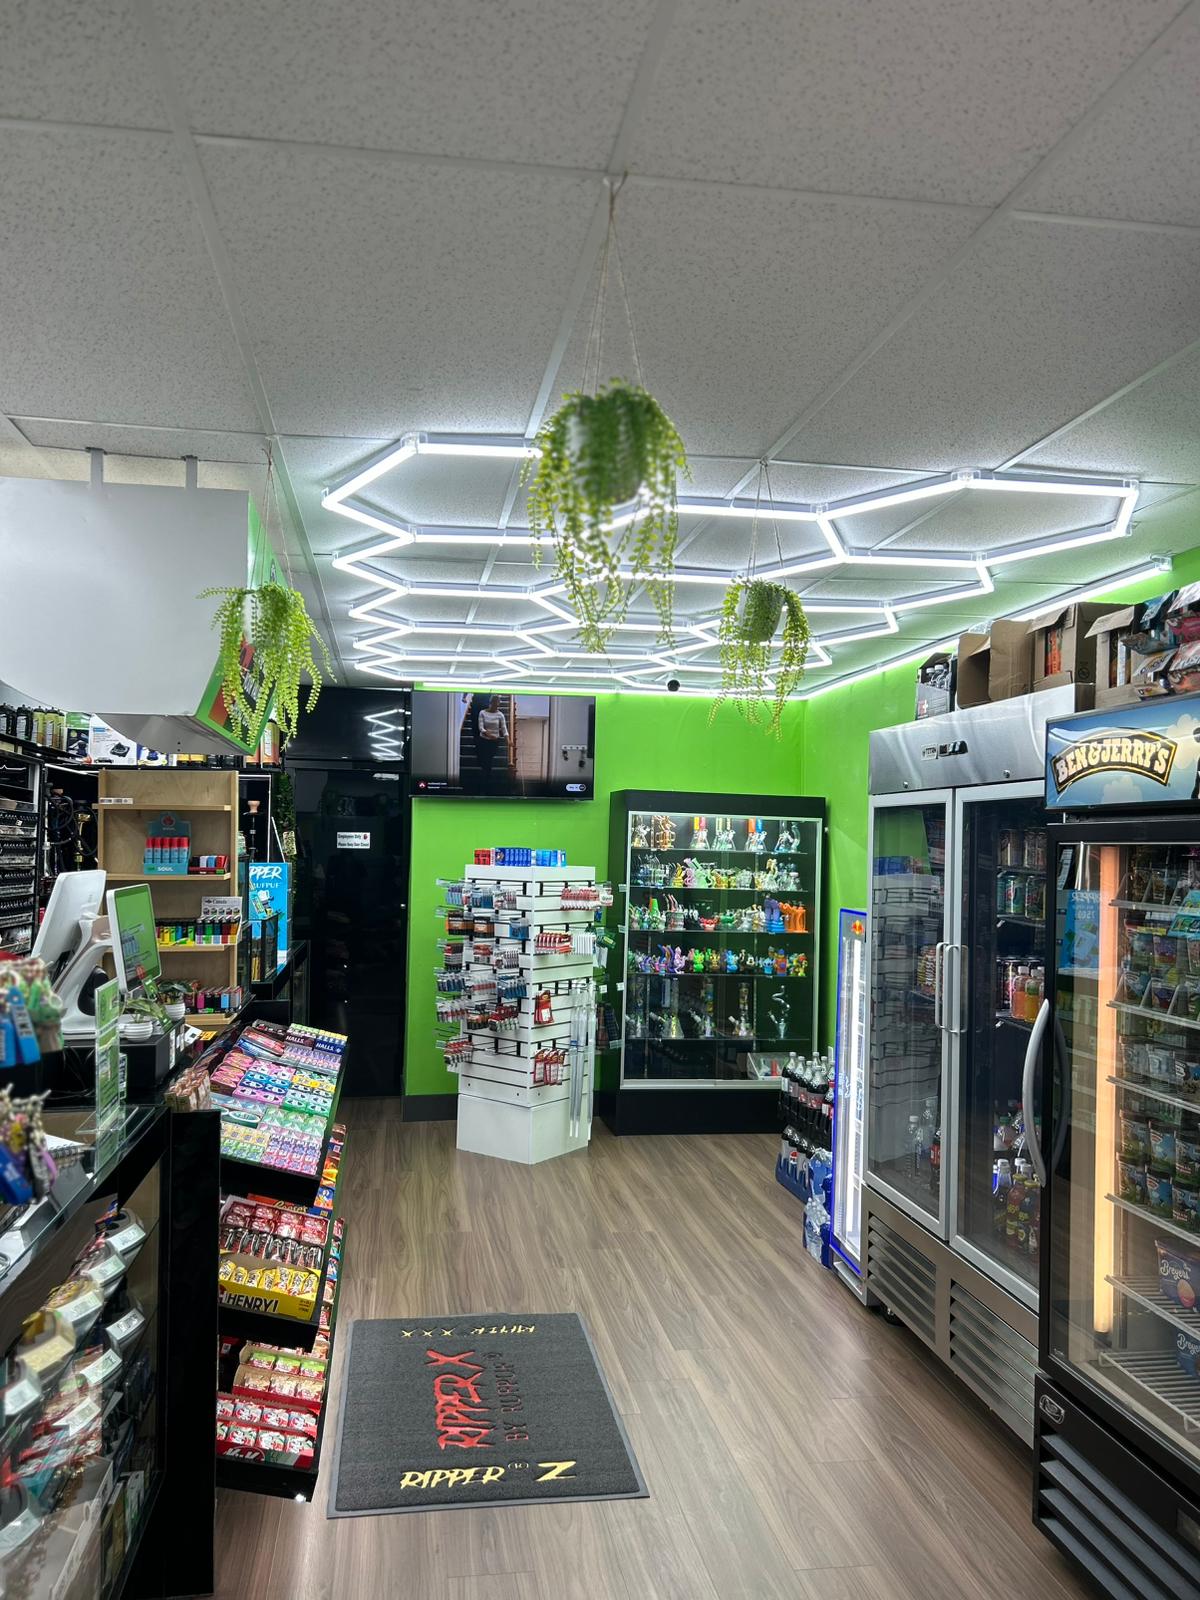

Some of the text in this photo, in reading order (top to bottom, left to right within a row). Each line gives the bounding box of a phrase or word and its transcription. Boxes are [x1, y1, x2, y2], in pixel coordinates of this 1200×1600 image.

[315, 1042, 335, 1051] HALLS
[1159, 1259, 1190, 1281] Breyers
[503, 1422, 529, 1441] BY
[400, 1461, 577, 1490] RIPPER Z
